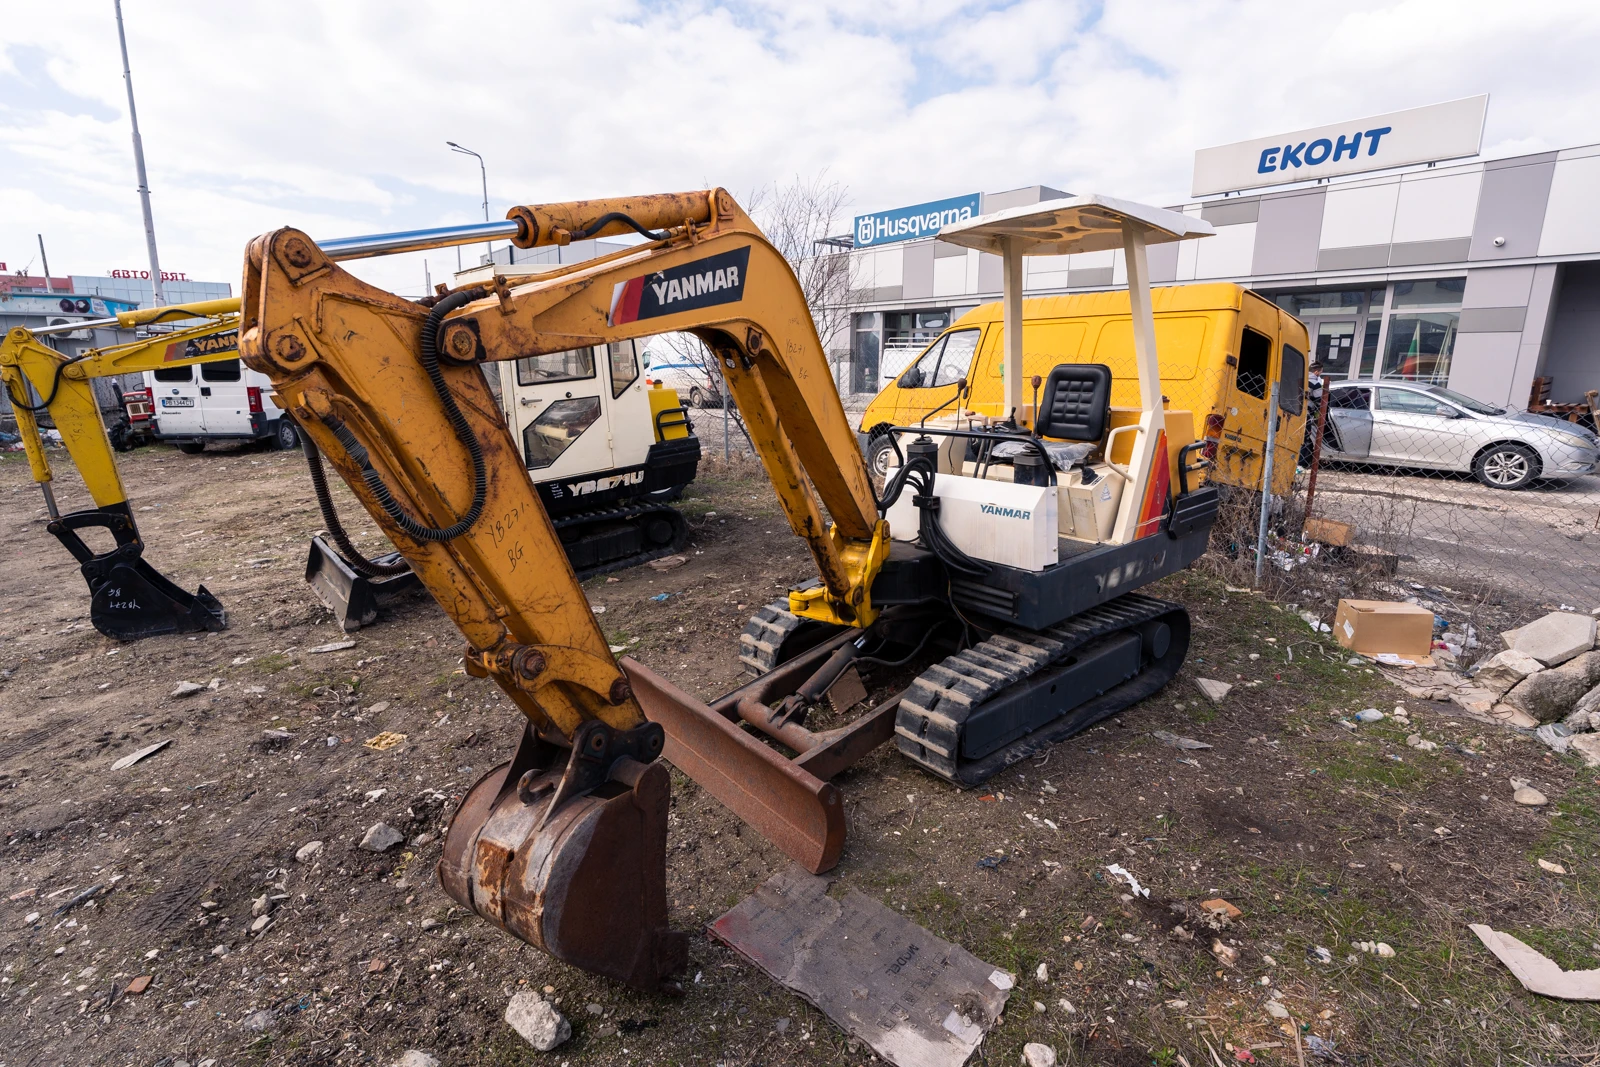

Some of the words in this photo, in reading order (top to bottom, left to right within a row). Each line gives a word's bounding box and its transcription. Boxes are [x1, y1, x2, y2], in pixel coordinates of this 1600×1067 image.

[1257, 126, 1392, 174] ЕКОНТ
[876, 206, 972, 238] Husqvarna
[112, 269, 186, 282] АВТОВЯТ
[652, 266, 739, 305] YANMAR
[980, 504, 1031, 520] YANMAR
